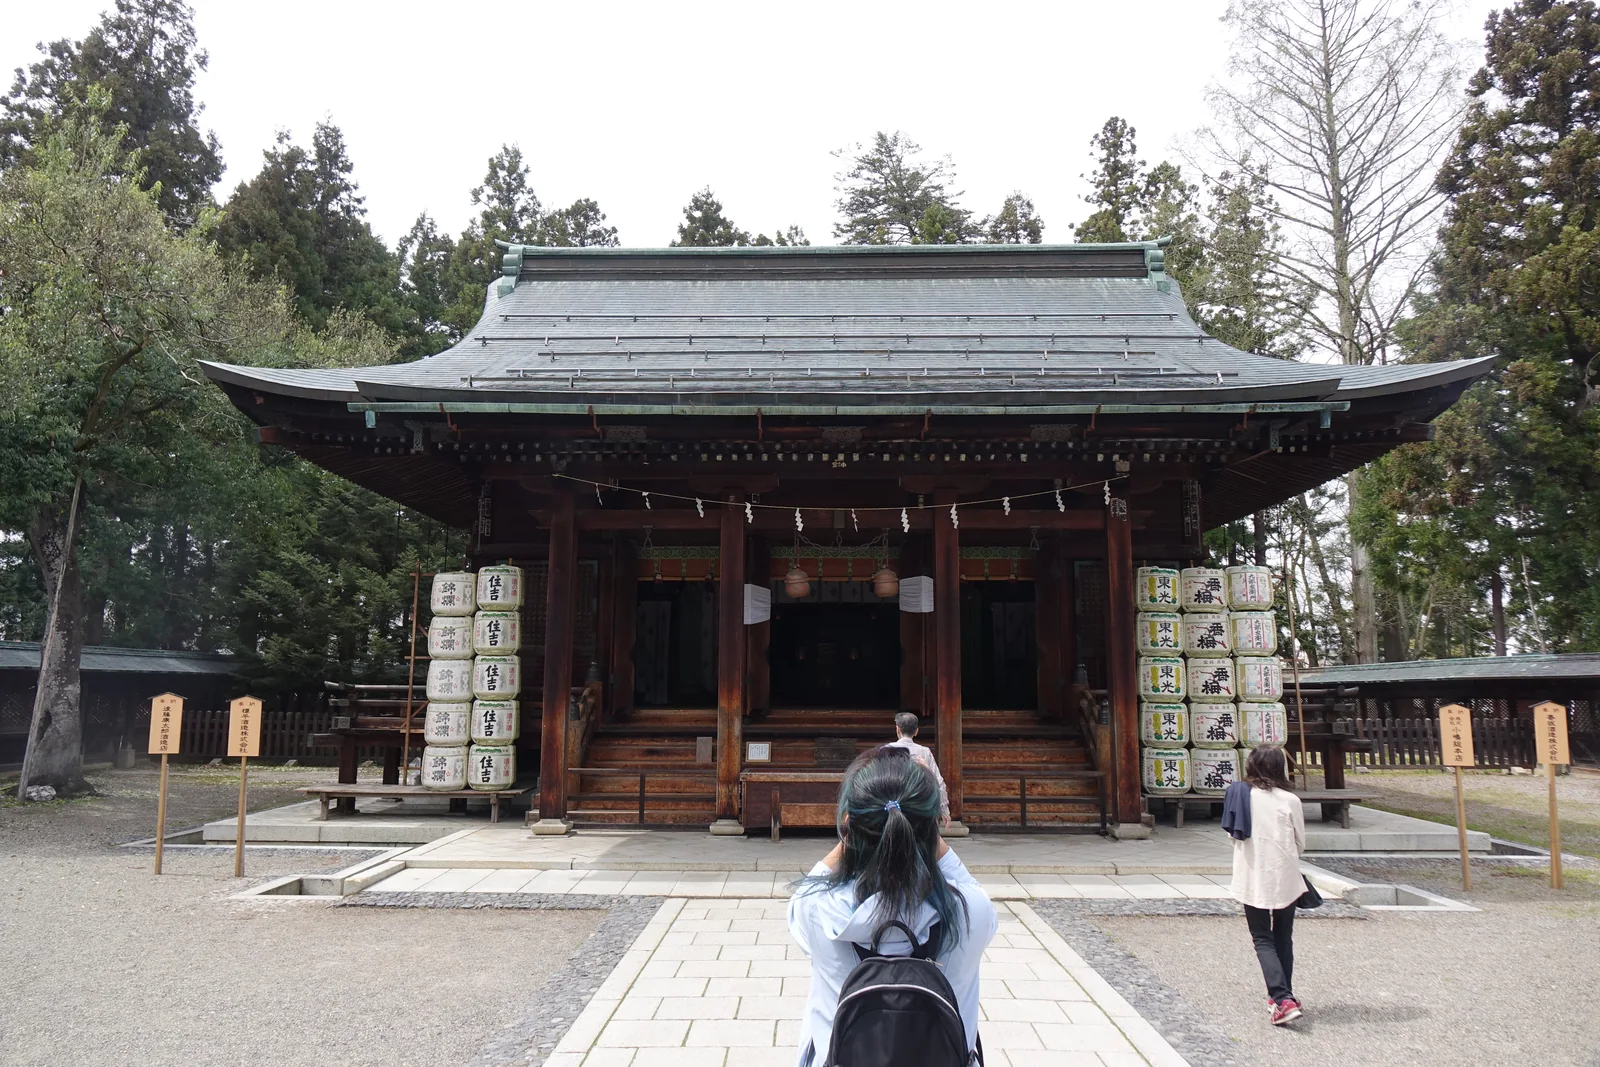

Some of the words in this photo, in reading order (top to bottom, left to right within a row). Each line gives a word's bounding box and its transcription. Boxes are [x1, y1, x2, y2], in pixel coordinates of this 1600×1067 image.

[489, 575, 502, 601] 住吉
[1157, 576, 1172, 604] 東光
[1194, 578, 1222, 604] 香梅
[487, 620, 501, 646] 住吉
[1158, 620, 1173, 648] 東光
[1196, 622, 1225, 649] 香梅
[486, 664, 499, 691] 住吉
[1160, 665, 1175, 694] 東光
[1201, 667, 1230, 695] 香梅
[483, 710, 496, 737] 住吉
[1162, 713, 1177, 740] 東光
[1206, 713, 1234, 740] 香梅
[480, 755, 493, 783] 住吉
[1163, 760, 1179, 787] 東光
[1204, 760, 1234, 788] 香梅
